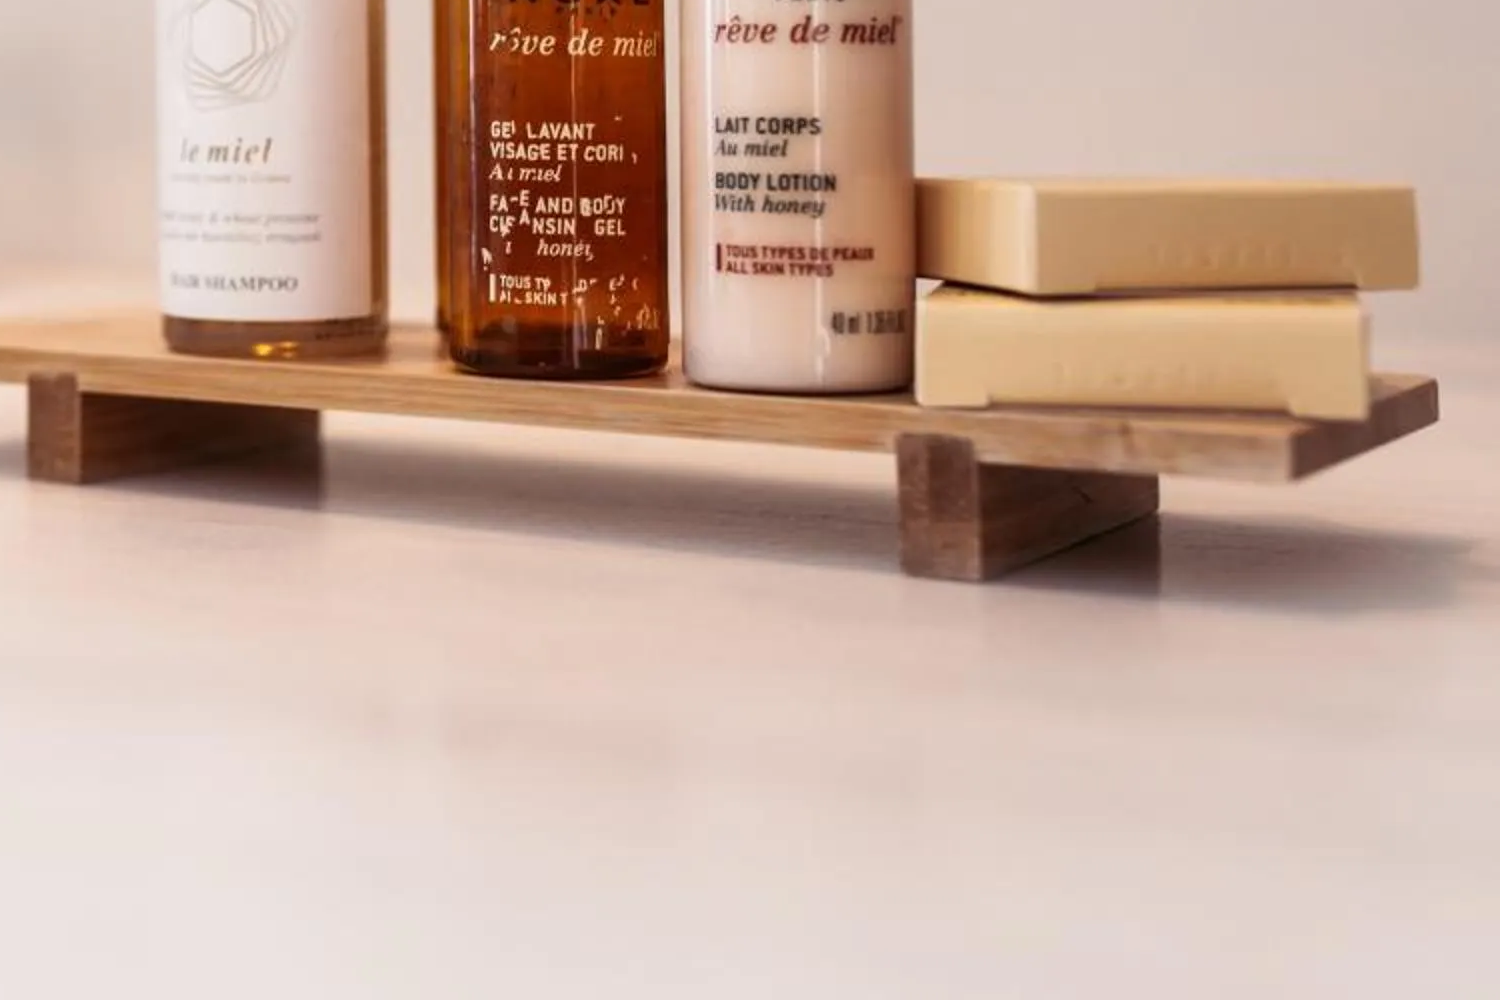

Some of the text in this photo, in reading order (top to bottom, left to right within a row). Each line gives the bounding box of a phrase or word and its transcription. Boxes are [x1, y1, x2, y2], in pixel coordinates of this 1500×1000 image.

[713, 13, 899, 46] rêve de miel
[567, 27, 605, 56] de
[612, 30, 658, 58] miel
[525, 121, 596, 141] LAVANT
[715, 116, 822, 136] LAIT CORPS
[180, 136, 273, 165] le miel
[489, 141, 550, 160] VISAGE
[556, 143, 579, 162] ET
[716, 138, 790, 158] Au miel
[715, 172, 838, 193] BODY LOTION
[489, 189, 530, 213] FAE
[534, 196, 574, 215] AND
[714, 194, 827, 218] With honey
[594, 218, 627, 236] GEL
[726, 245, 758, 259] TOUS
[761, 246, 807, 261] TYPES
[726, 262, 748, 275] ALL
[752, 262, 785, 276] SKIN
[500, 274, 531, 290] TOUS
[525, 291, 557, 306] SKIN
